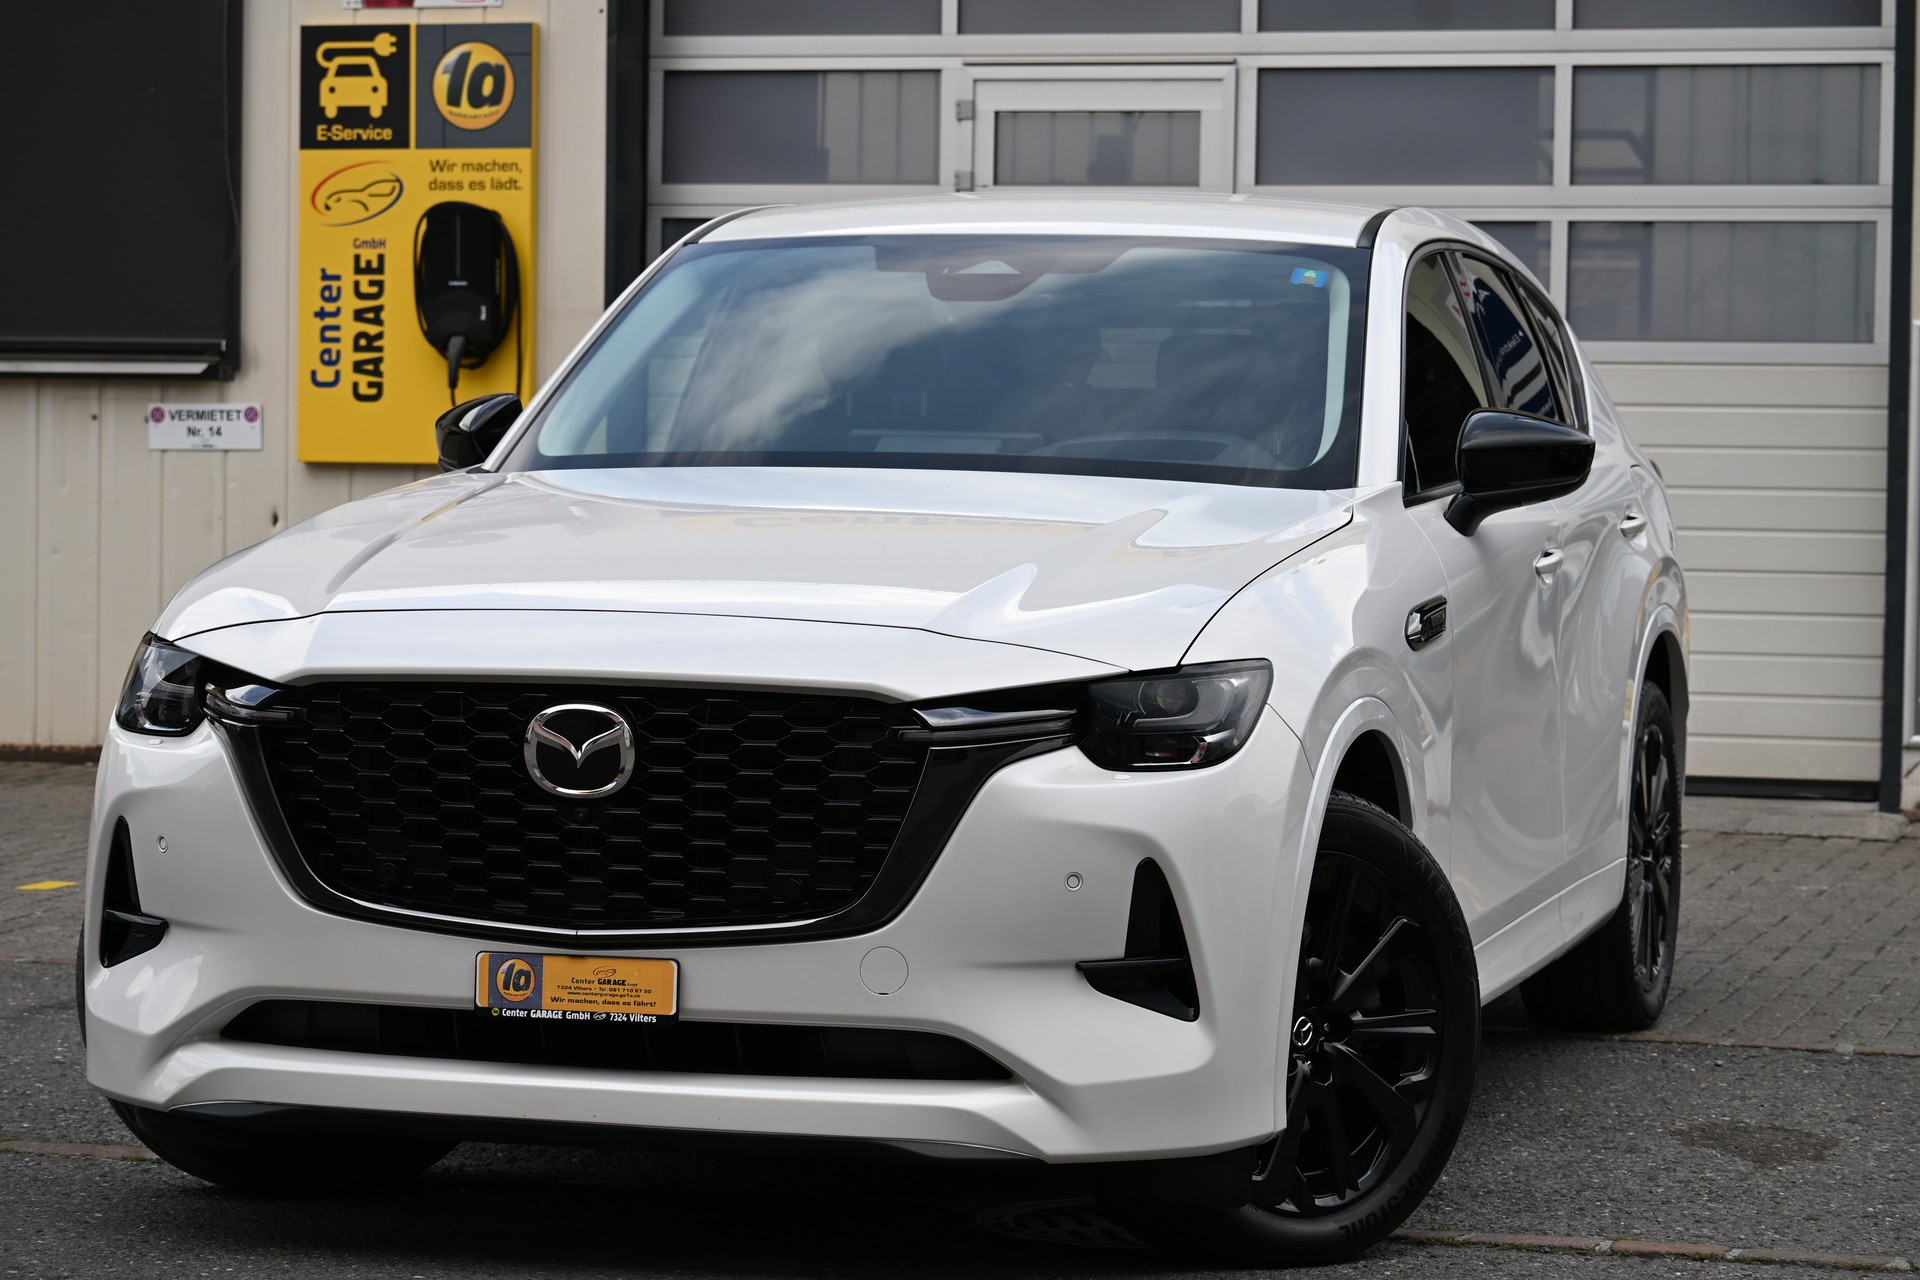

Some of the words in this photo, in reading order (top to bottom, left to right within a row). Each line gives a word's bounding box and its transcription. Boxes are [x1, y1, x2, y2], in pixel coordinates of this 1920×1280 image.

[441, 50, 506, 110] 1a
[316, 124, 393, 142] E-Service
[429, 160, 457, 173] Wir
[461, 159, 523, 175] machen,
[428, 178, 465, 191] dass
[469, 180, 487, 191] es
[490, 177, 524, 191] lädt.
[353, 238, 387, 249] GmbH
[311, 268, 342, 389] Center
[353, 253, 385, 403] GARAGE
[168, 409, 242, 422] VERMIETET
[186, 426, 204, 437] Nr.
[208, 426, 223, 437] 14
[501, 962, 532, 992] 1a
[571, 977, 595, 985] Center
[597, 978, 627, 987] GARAGE
[502, 1008, 528, 1017] Center
[530, 1009, 563, 1019] GARAGE
[565, 1011, 591, 1020] GmbH
[609, 1012, 628, 1022] 7324
[629, 1013, 657, 1023] Vilters
